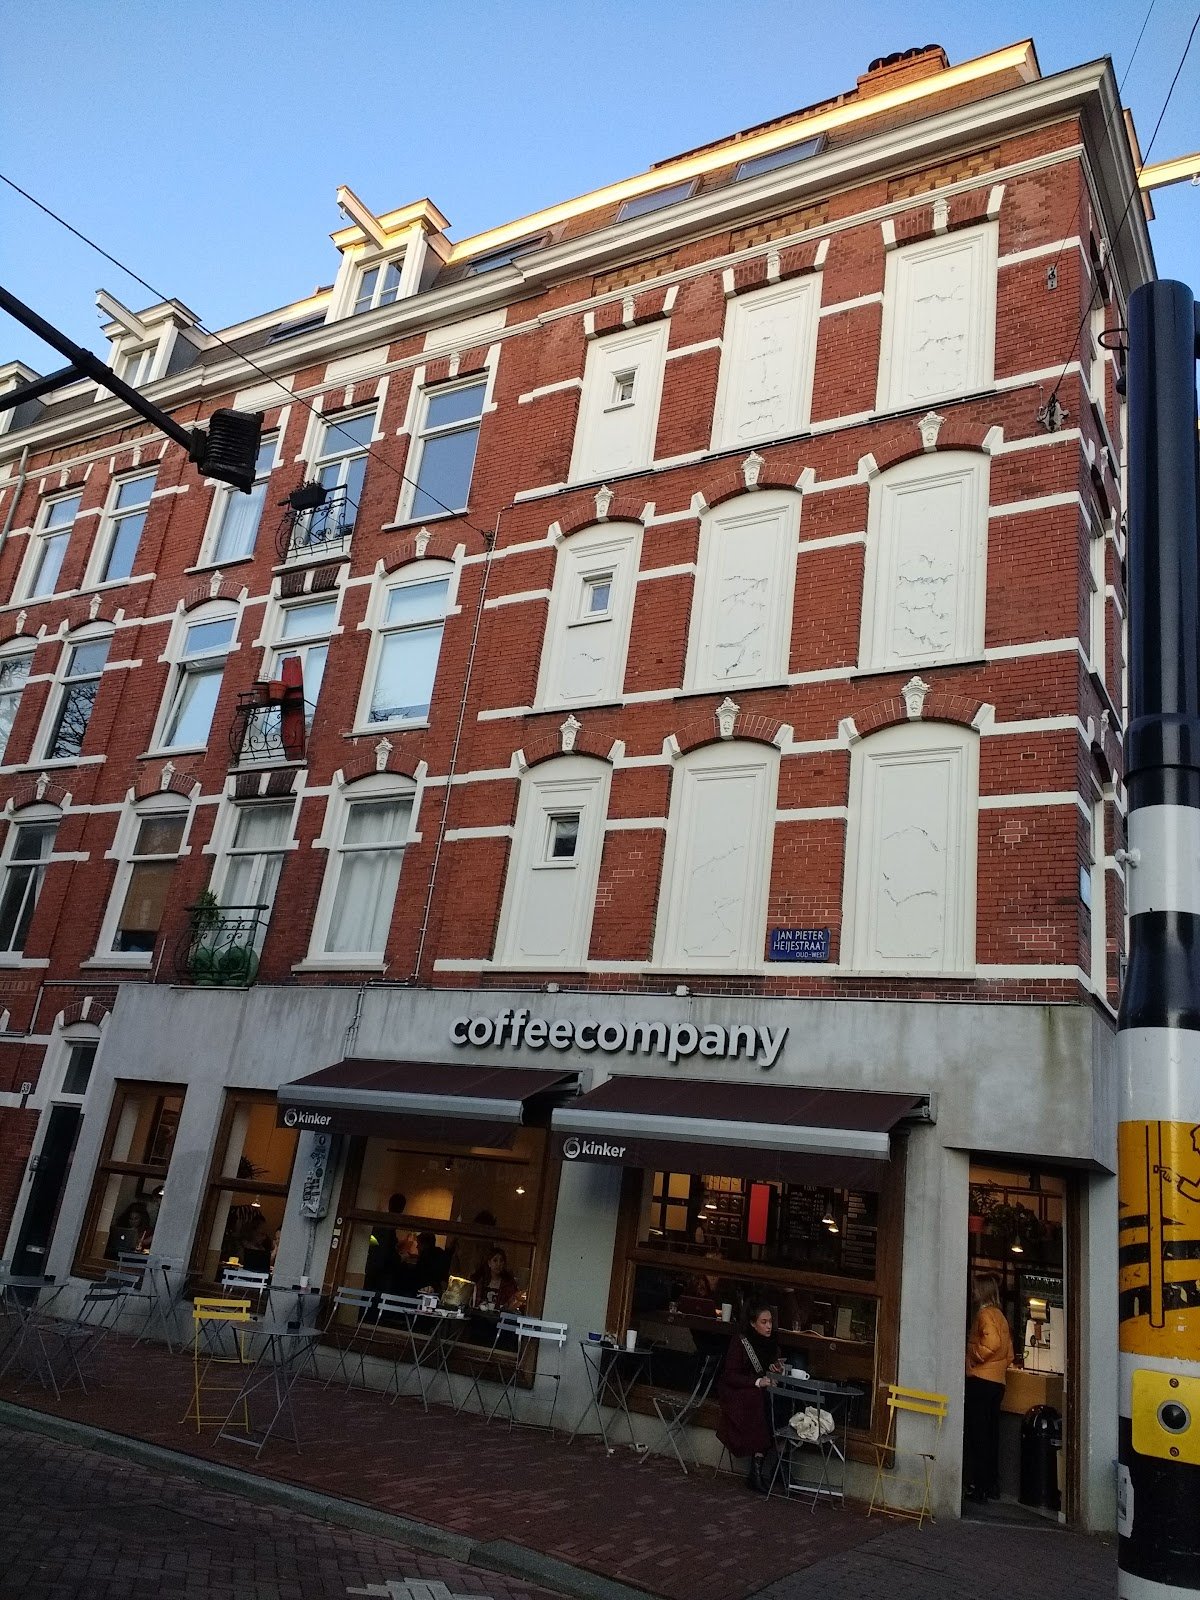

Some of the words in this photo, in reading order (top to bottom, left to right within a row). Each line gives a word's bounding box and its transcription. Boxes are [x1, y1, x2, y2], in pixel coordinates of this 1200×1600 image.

[777, 930, 793, 942] JAN
[795, 930, 824, 941] PIETER
[773, 941, 827, 953] HEIJESTRAAT
[449, 1007, 790, 1068] coffeecompany
[298, 1111, 332, 1126] kinker
[581, 1140, 626, 1158] kinker
